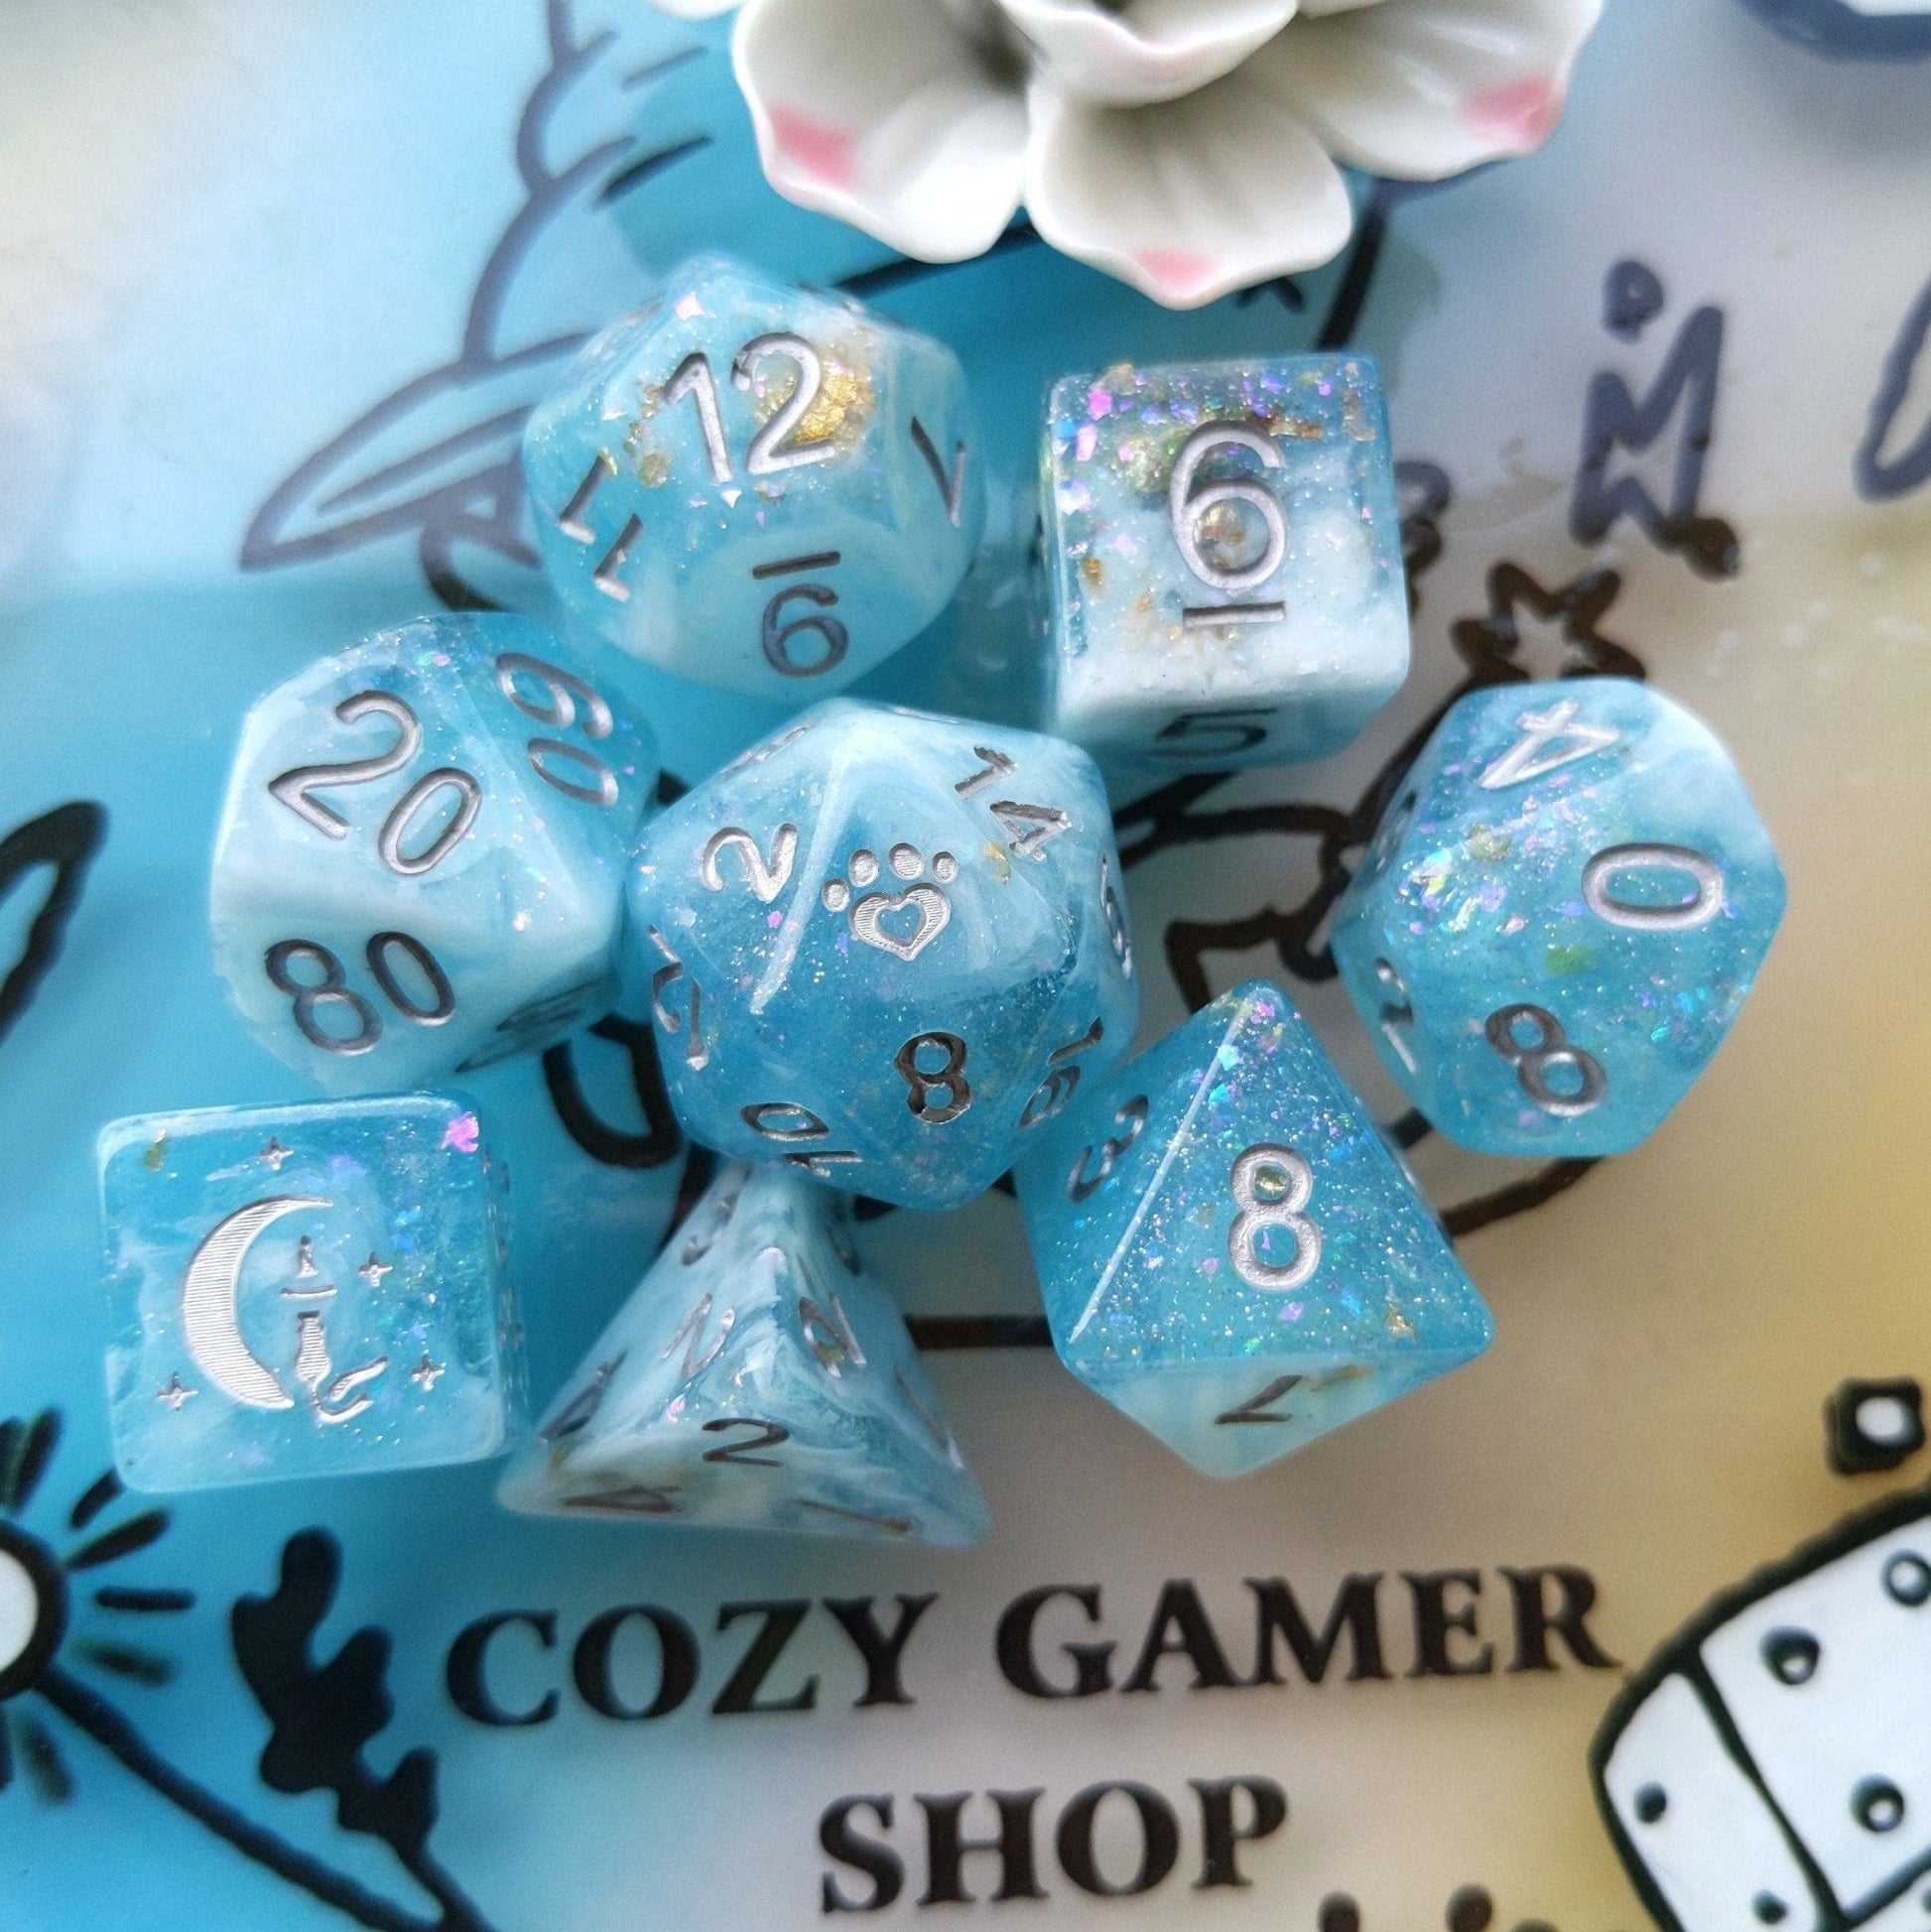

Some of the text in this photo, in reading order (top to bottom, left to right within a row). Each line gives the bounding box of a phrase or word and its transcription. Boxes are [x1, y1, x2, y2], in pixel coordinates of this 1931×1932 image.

[660, 331, 836, 484] 12
[1170, 420, 1288, 630] 6
[269, 689, 481, 876] 20
[954, 745, 1072, 862] 14
[1478, 700, 1620, 789] 4
[702, 822, 798, 904] 2
[1581, 841, 1724, 932] 0
[264, 930, 456, 1057] 80
[894, 1030, 973, 1124] 8
[1483, 1002, 1609, 1117] 8
[1226, 1141, 1324, 1290] 8
[702, 1417, 791, 1468] 2
[445, 1565, 1621, 1727] COZY GAMER
[818, 1775, 1288, 1915] SHOP
